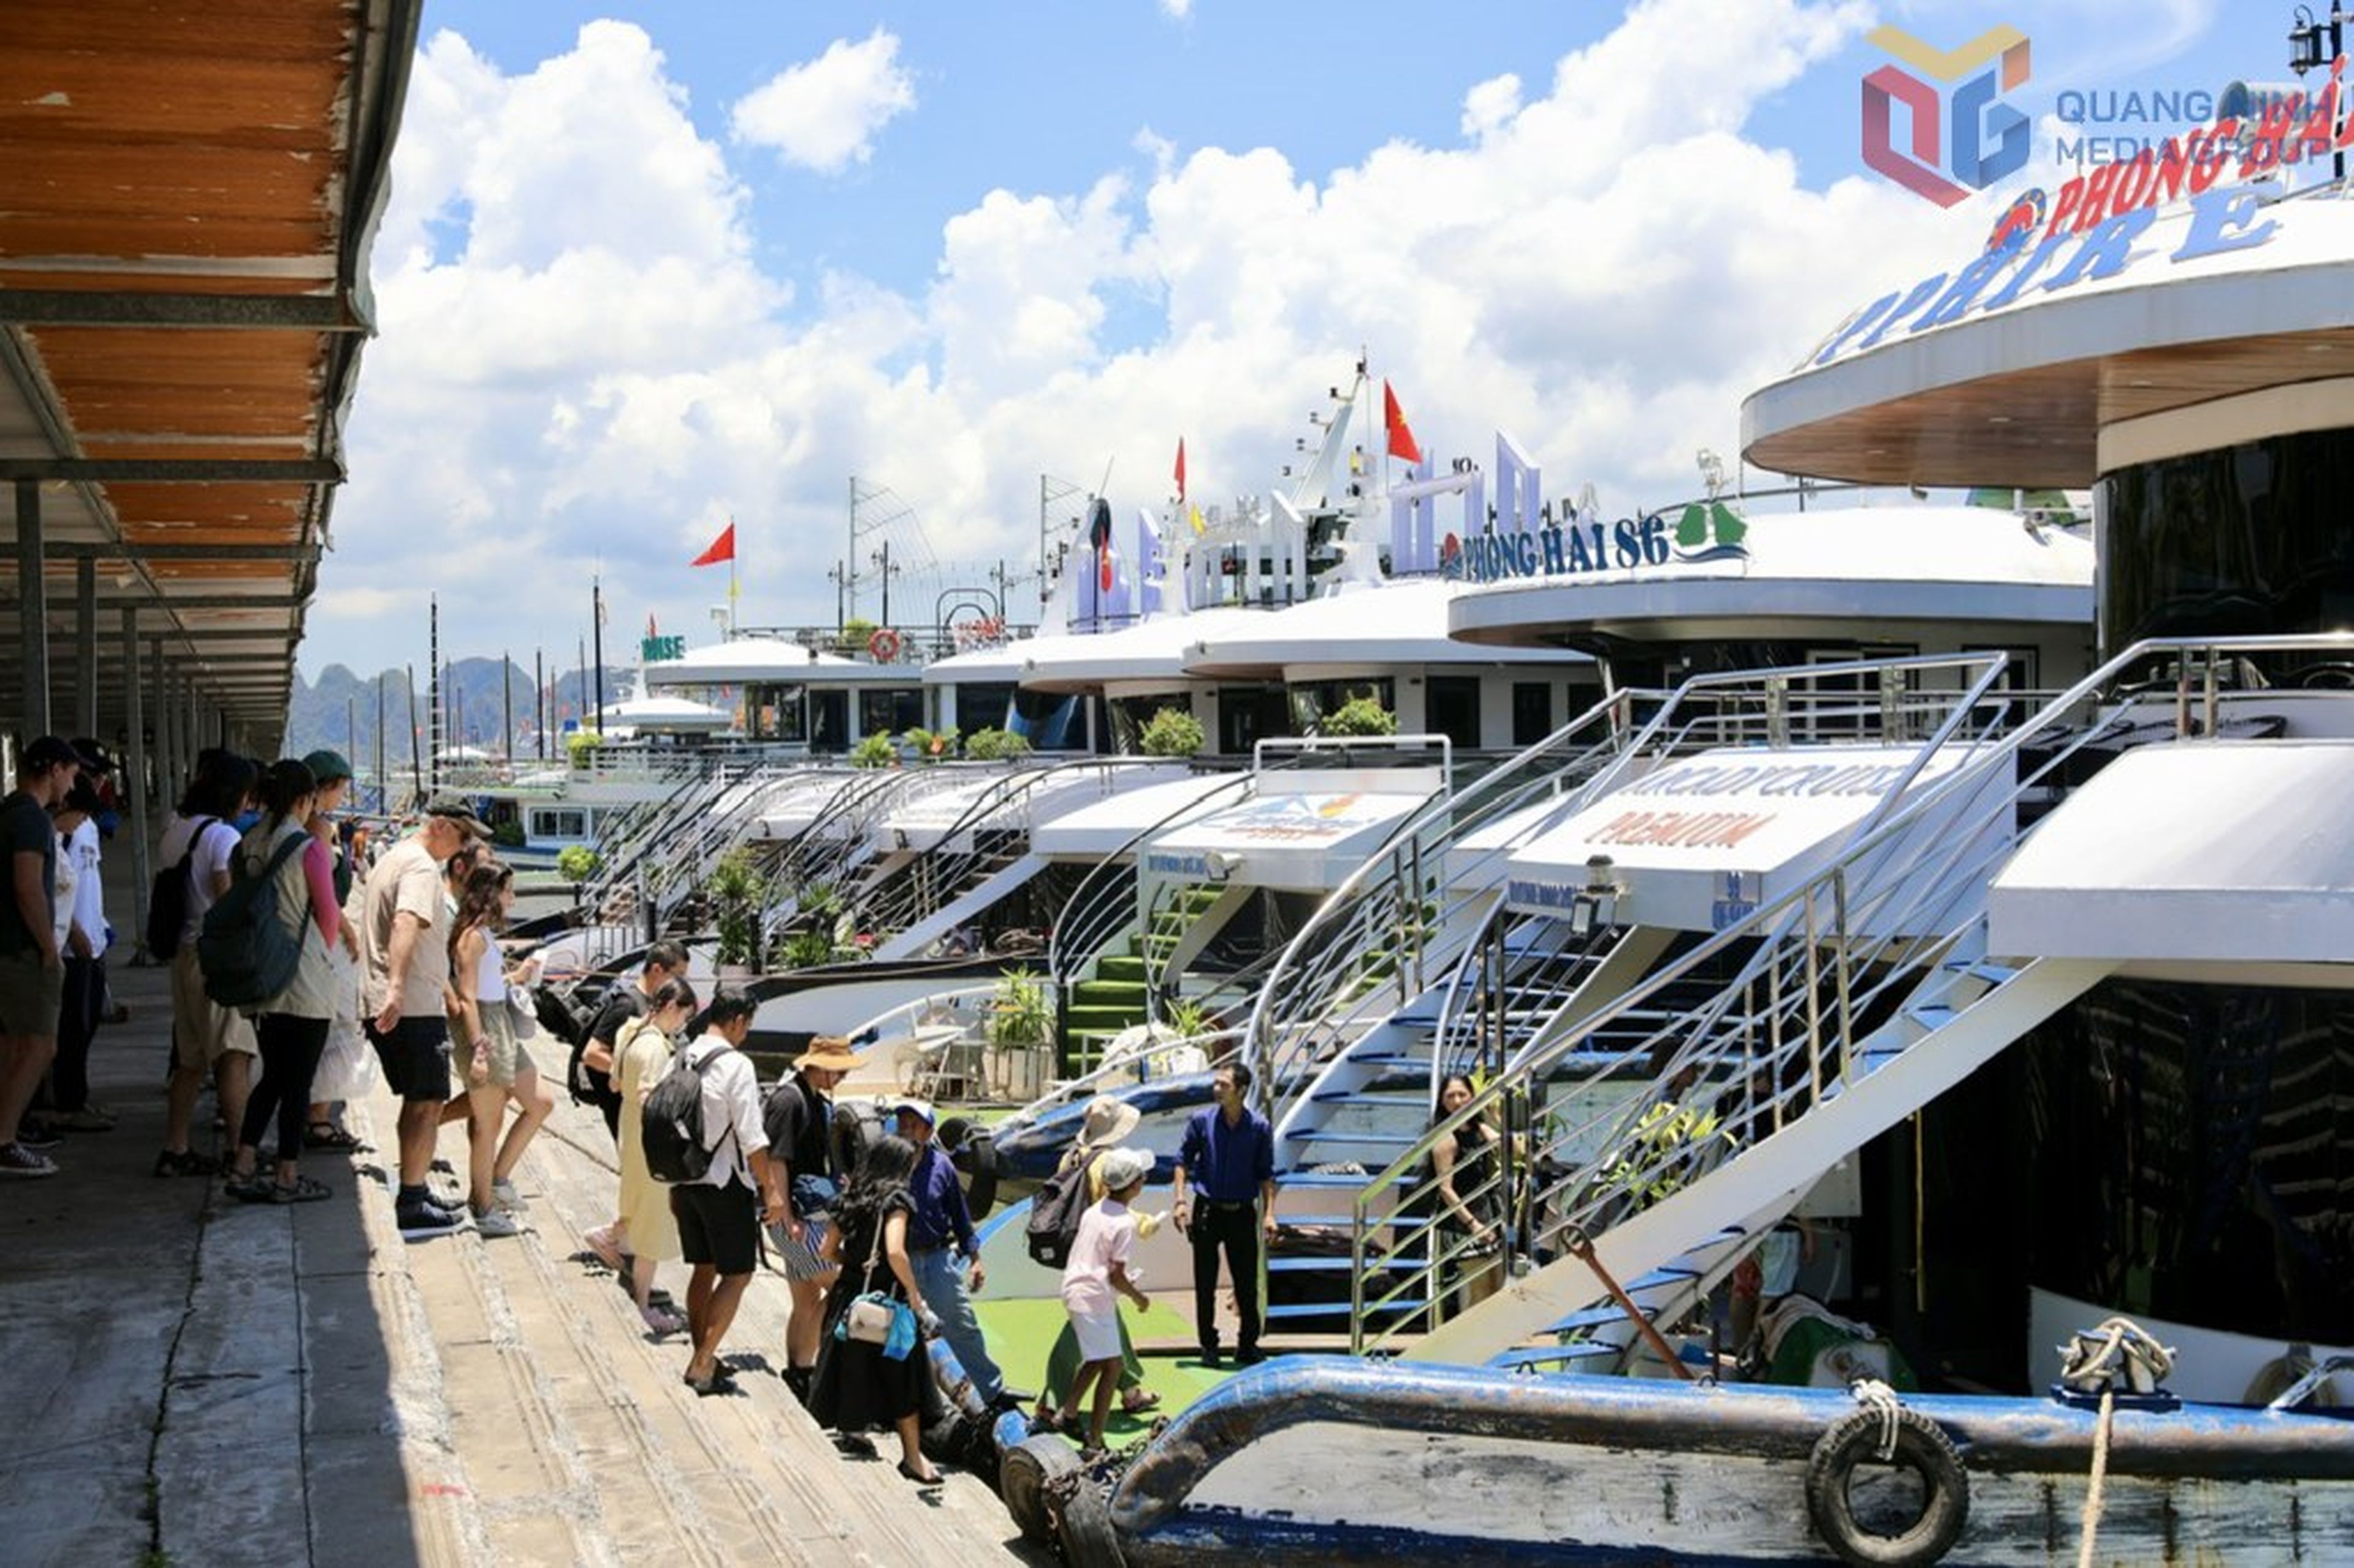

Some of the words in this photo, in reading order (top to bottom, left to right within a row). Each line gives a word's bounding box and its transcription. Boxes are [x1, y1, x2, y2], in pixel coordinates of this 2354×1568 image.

[2043, 118, 2239, 243] PHONG
[1464, 531, 1537, 583] PHONG
[1614, 515, 1669, 568] 86
